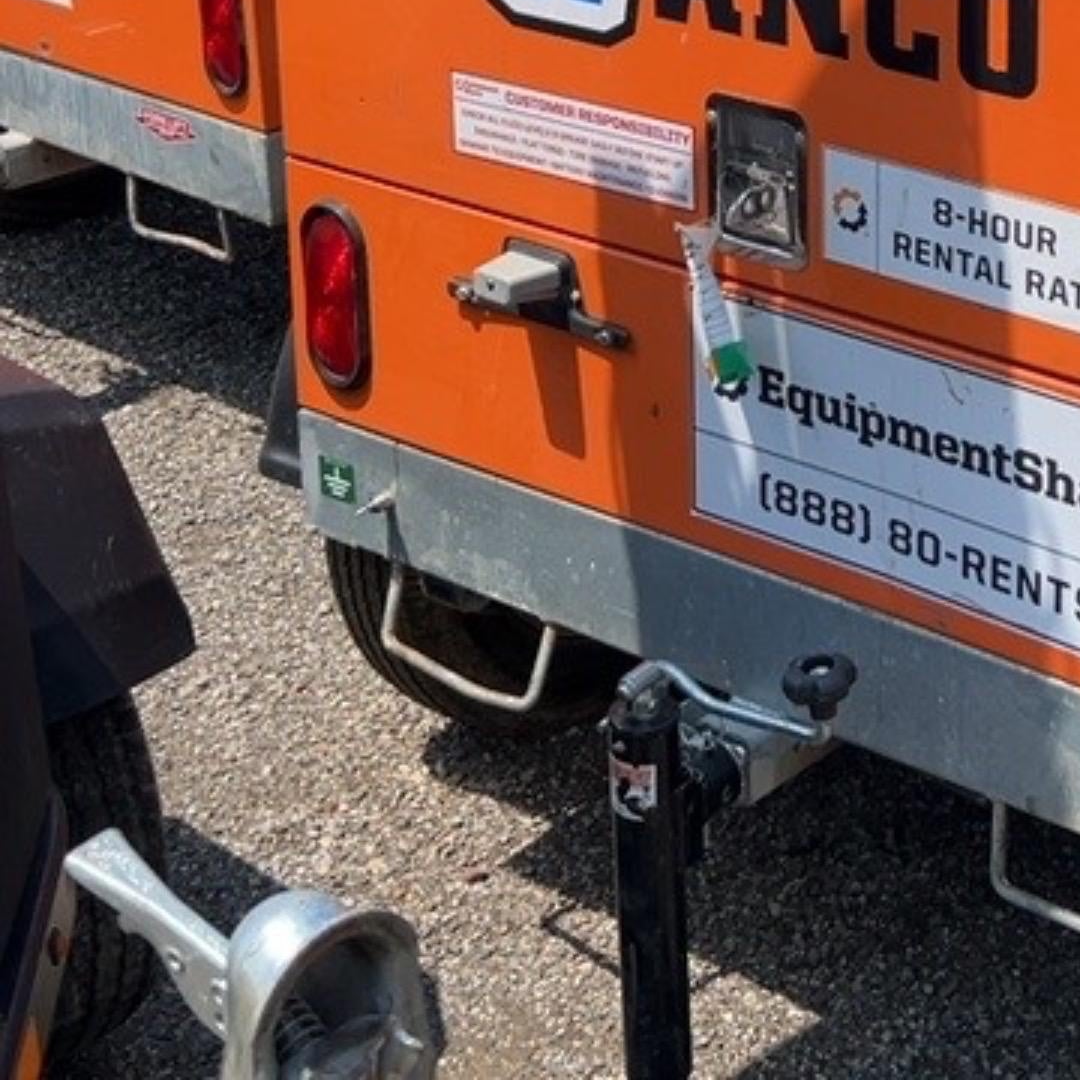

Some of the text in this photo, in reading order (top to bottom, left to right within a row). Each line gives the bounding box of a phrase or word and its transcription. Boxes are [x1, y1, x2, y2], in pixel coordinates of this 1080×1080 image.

[505, 89, 577, 119] CUSTOMER
[577, 106, 691, 146] RESPONSIBILITY
[932, 197, 1058, 257] 8-HOUR
[892, 232, 1012, 291] RENTAL
[759, 472, 871, 546] (888)
